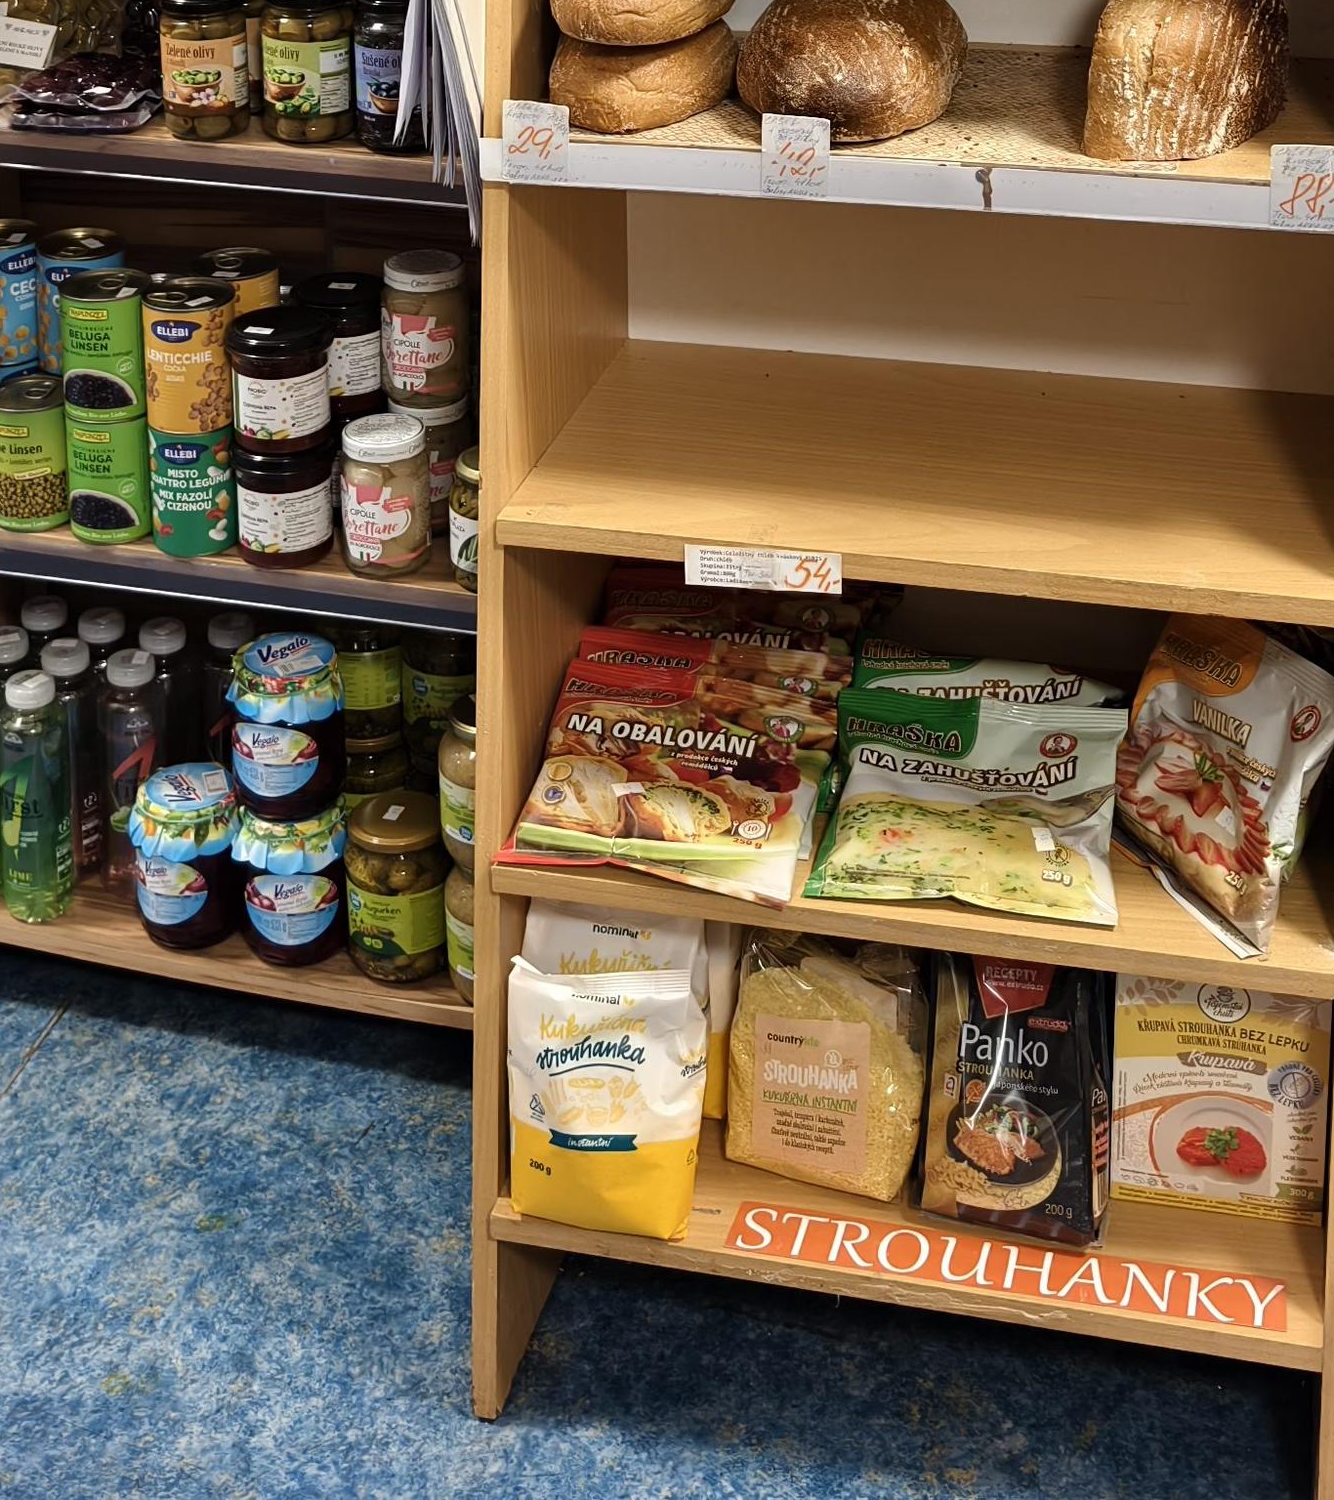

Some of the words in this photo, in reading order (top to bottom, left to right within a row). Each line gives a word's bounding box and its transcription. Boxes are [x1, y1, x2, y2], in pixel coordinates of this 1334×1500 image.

[69, 330, 109, 343] BELUGA
[156, 324, 189, 338] ELLEBI
[70, 339, 109, 352] LINSEN
[393, 338, 421, 350] CIPOLLE
[147, 348, 213, 364] LENTICCHIE
[8, 443, 43, 456] Linsen
[167, 468, 198, 478] MISTO
[160, 490, 174, 499] MIX
[176, 488, 213, 501] FAZOLÍ
[167, 501, 213, 512] CIZRNOU
[257, 636, 308, 664] Vegalo
[1192, 700, 1251, 747] VANILKA
[567, 713, 604, 736] NA
[611, 720, 758, 758] OBALOVÁNÍ
[847, 716, 962, 753] HRAŠKA
[860, 748, 898, 772] NA
[902, 756, 1079, 792] ZAHUŠŤOVÁNÍ
[1042, 869, 1062, 883] 250
[986, 967, 1037, 982] RECEPTY
[1138, 1020, 1176, 1034] KŘUPAVÁ
[1178, 1021, 1237, 1038] STROUHANKA
[1239, 1029, 1265, 1041] BEZ
[1268, 1033, 1310, 1053] LEPKU
[537, 1034, 645, 1070] strouhanka
[960, 1023, 1048, 1068] Panko
[764, 1059, 858, 1094] STROUHANKA
[529, 1158, 543, 1172] 200
[735, 1206, 1285, 1328] STROUHANKY
